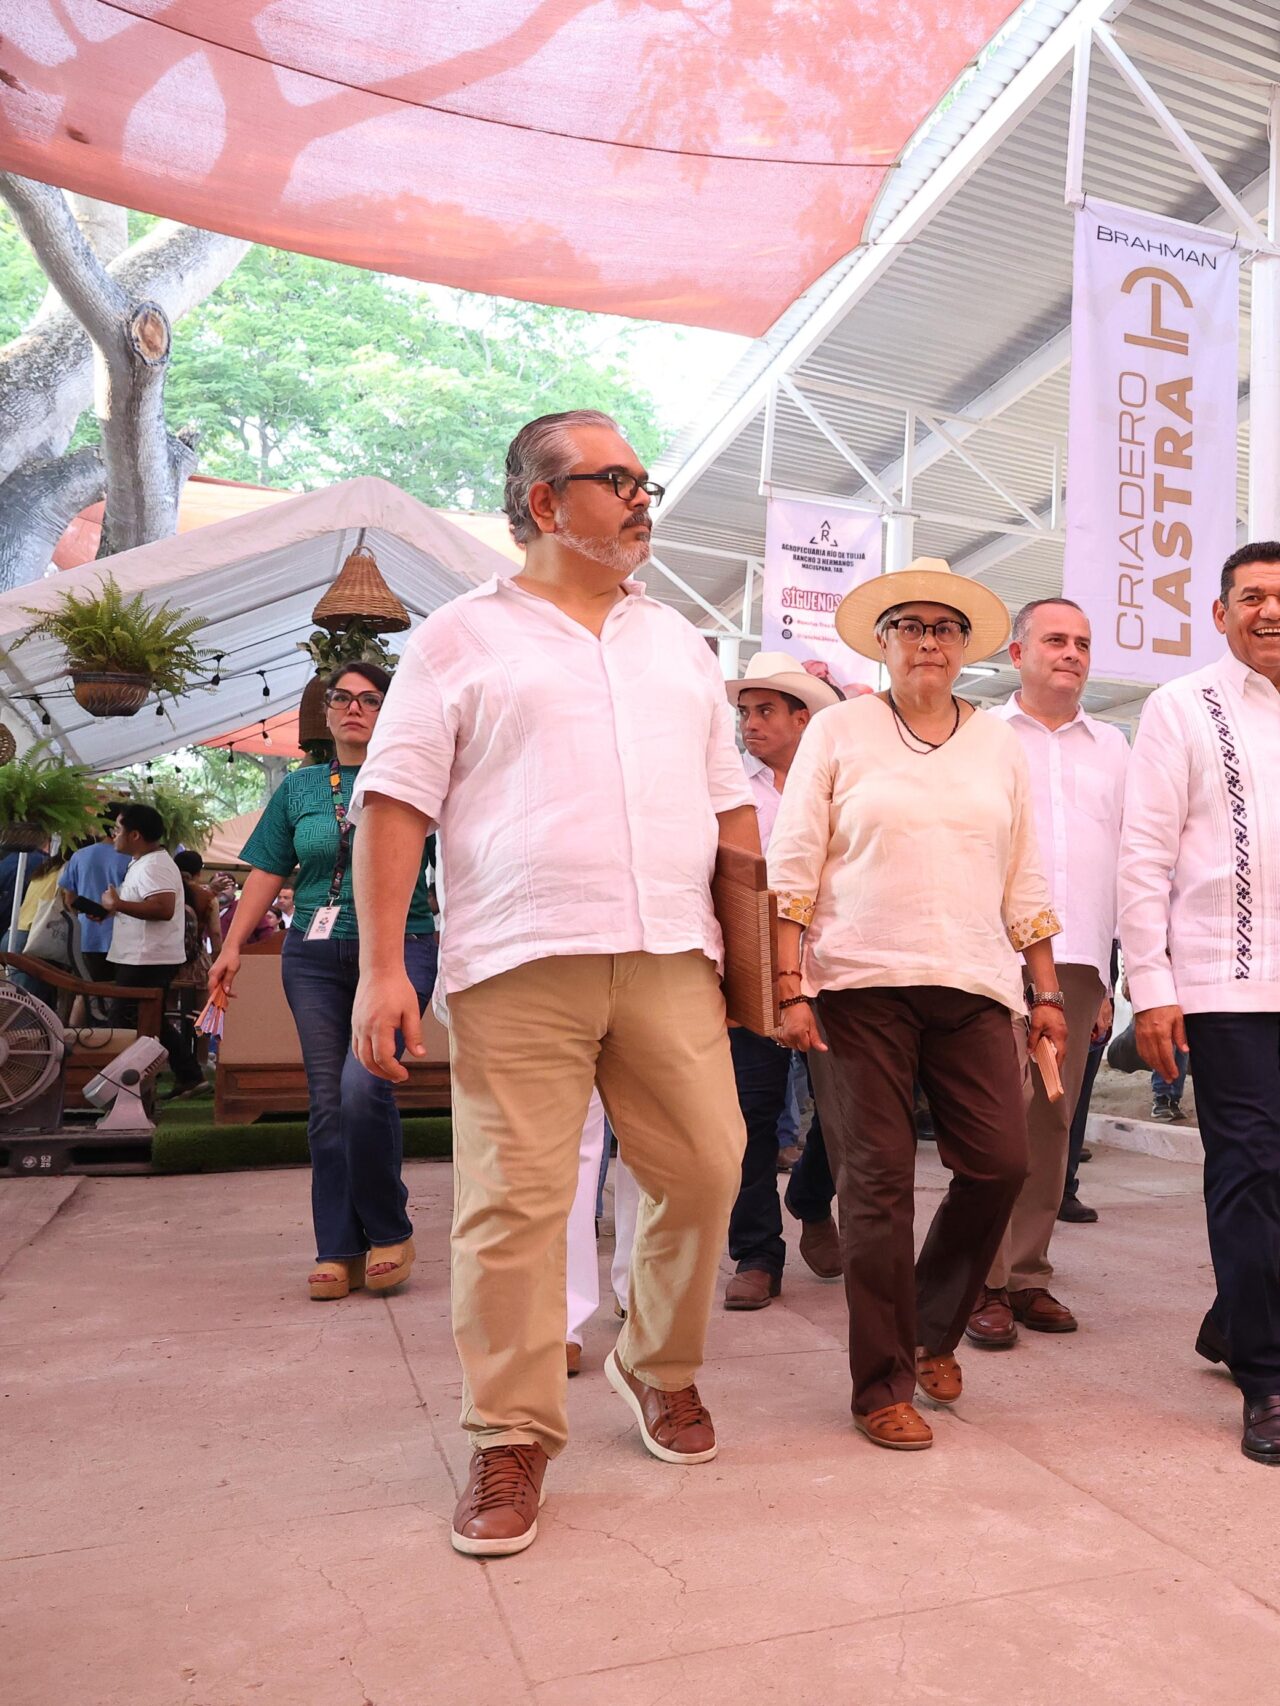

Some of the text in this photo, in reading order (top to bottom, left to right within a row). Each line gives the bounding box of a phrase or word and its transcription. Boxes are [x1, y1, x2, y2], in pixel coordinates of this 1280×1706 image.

[1097, 225, 1217, 271] BRAHMAN
[1116, 371, 1148, 651] CRIADERO
[1152, 376, 1193, 657] LASTRA
[781, 543, 826, 557] AGROPECUARIA
[838, 551, 845, 559] DE
[792, 554, 854, 567] RANCHO 3 HERMANOS
[781, 586, 843, 613] SÍGUENOS
